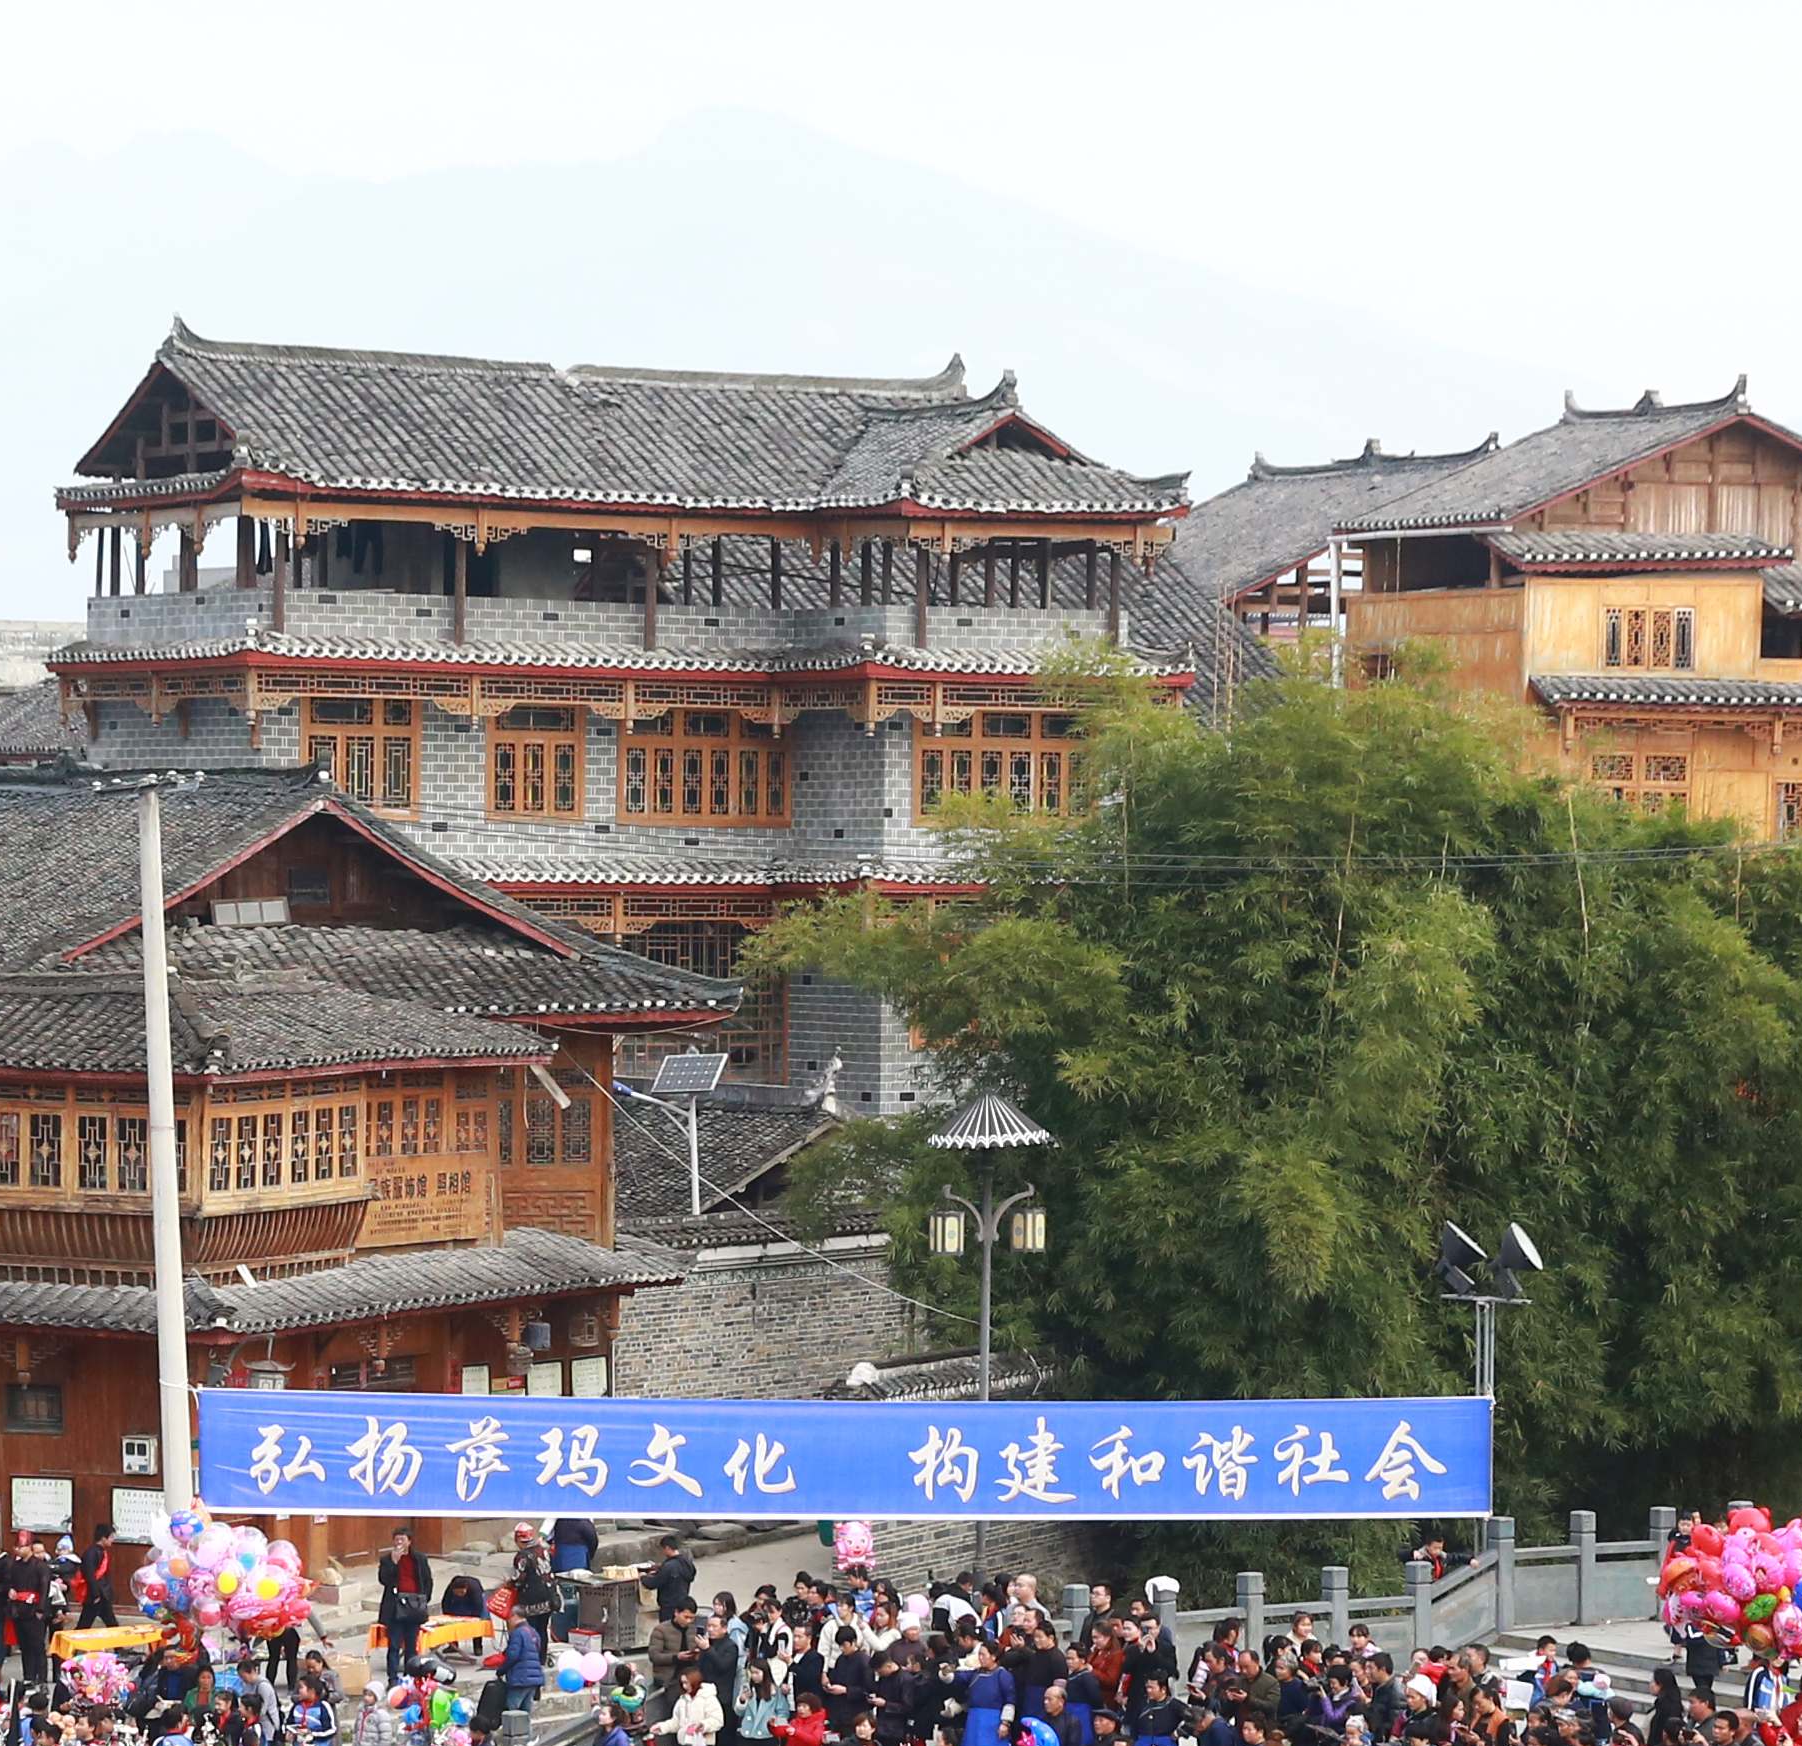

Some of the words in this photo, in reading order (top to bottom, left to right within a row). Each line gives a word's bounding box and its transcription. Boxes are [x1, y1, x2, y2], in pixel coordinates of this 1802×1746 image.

[248, 1414, 798, 1503] 弘扬萨玛文化
[907, 1415, 1449, 1503] 构建和谐社会
